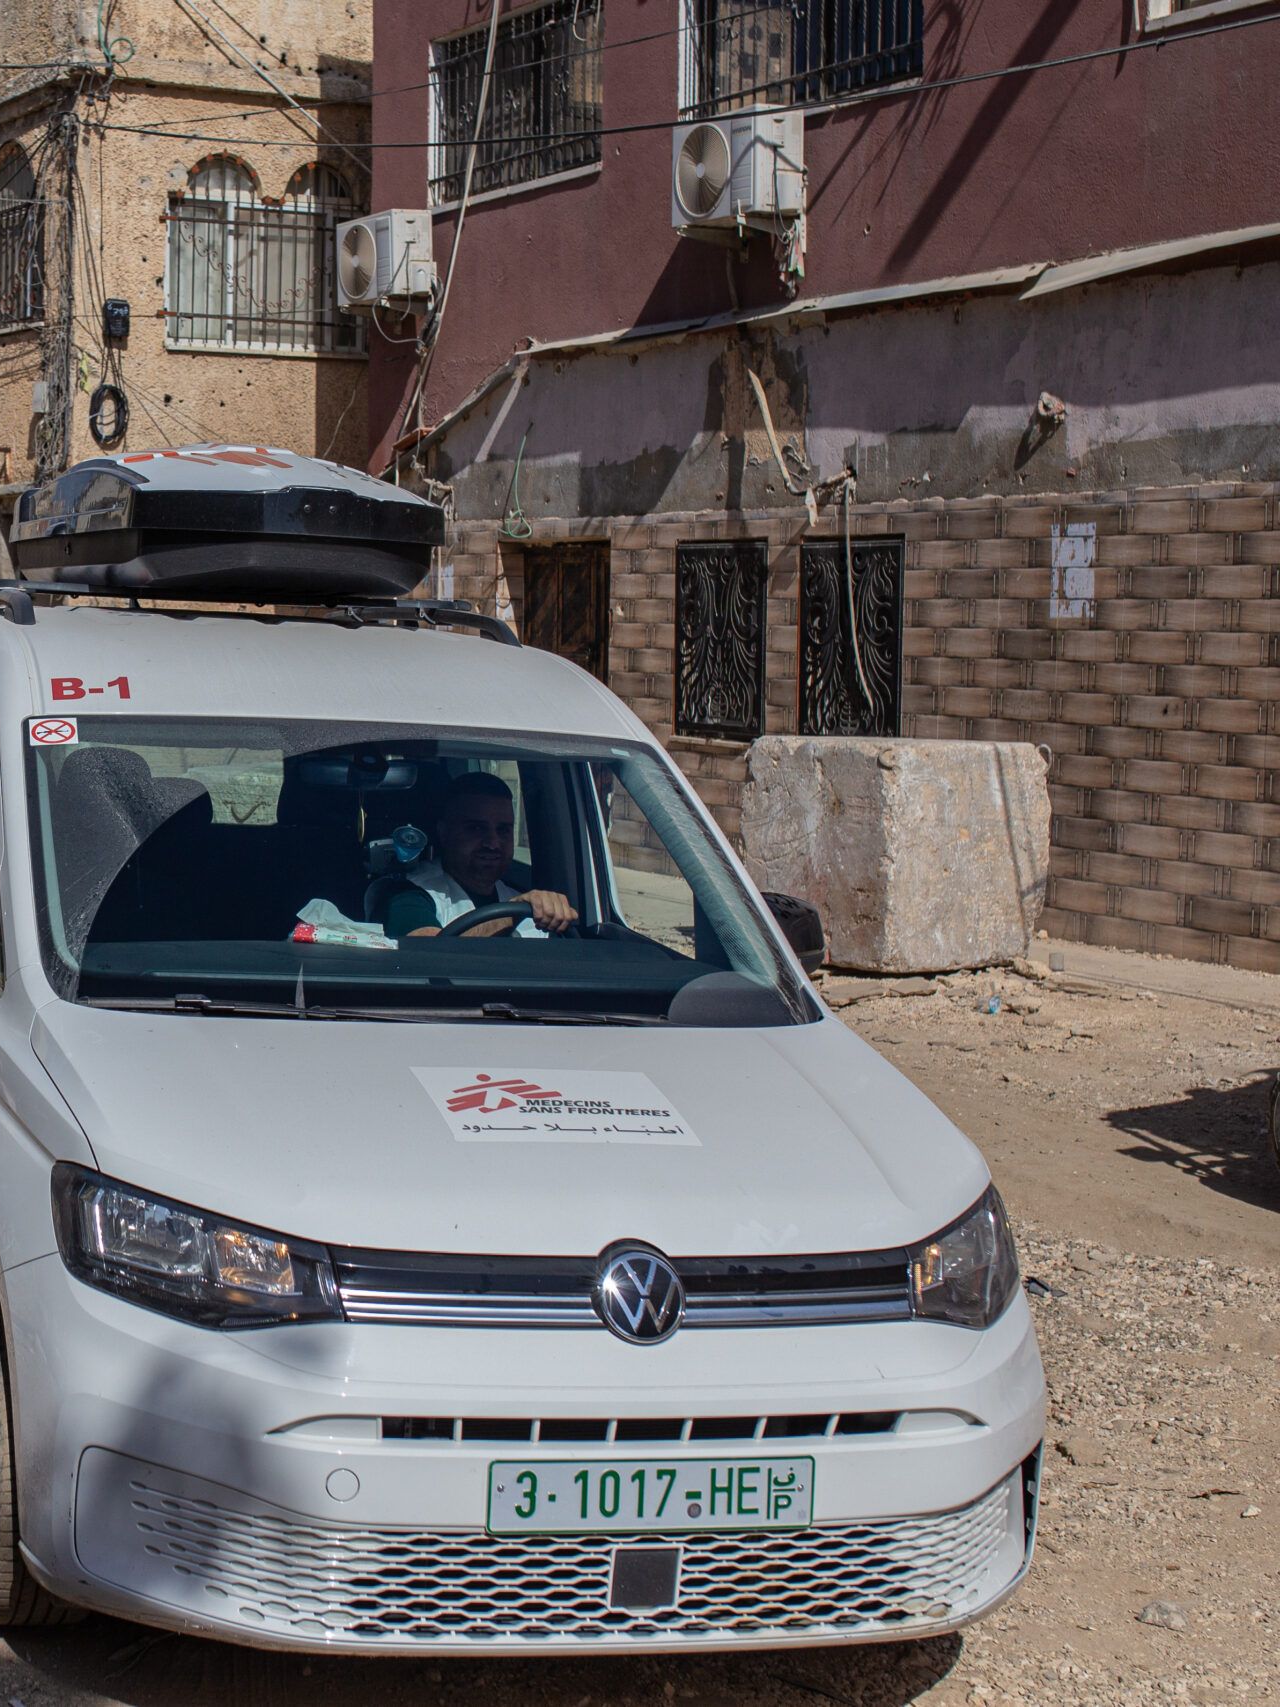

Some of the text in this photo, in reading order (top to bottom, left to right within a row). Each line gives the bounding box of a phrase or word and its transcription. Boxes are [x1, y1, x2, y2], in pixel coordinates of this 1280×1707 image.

[51, 676, 131, 700] B-1
[519, 1106, 671, 1117] SANS FRONTIERES
[526, 1099, 612, 1108] MEDECINS
[774, 1495, 792, 1519] P
